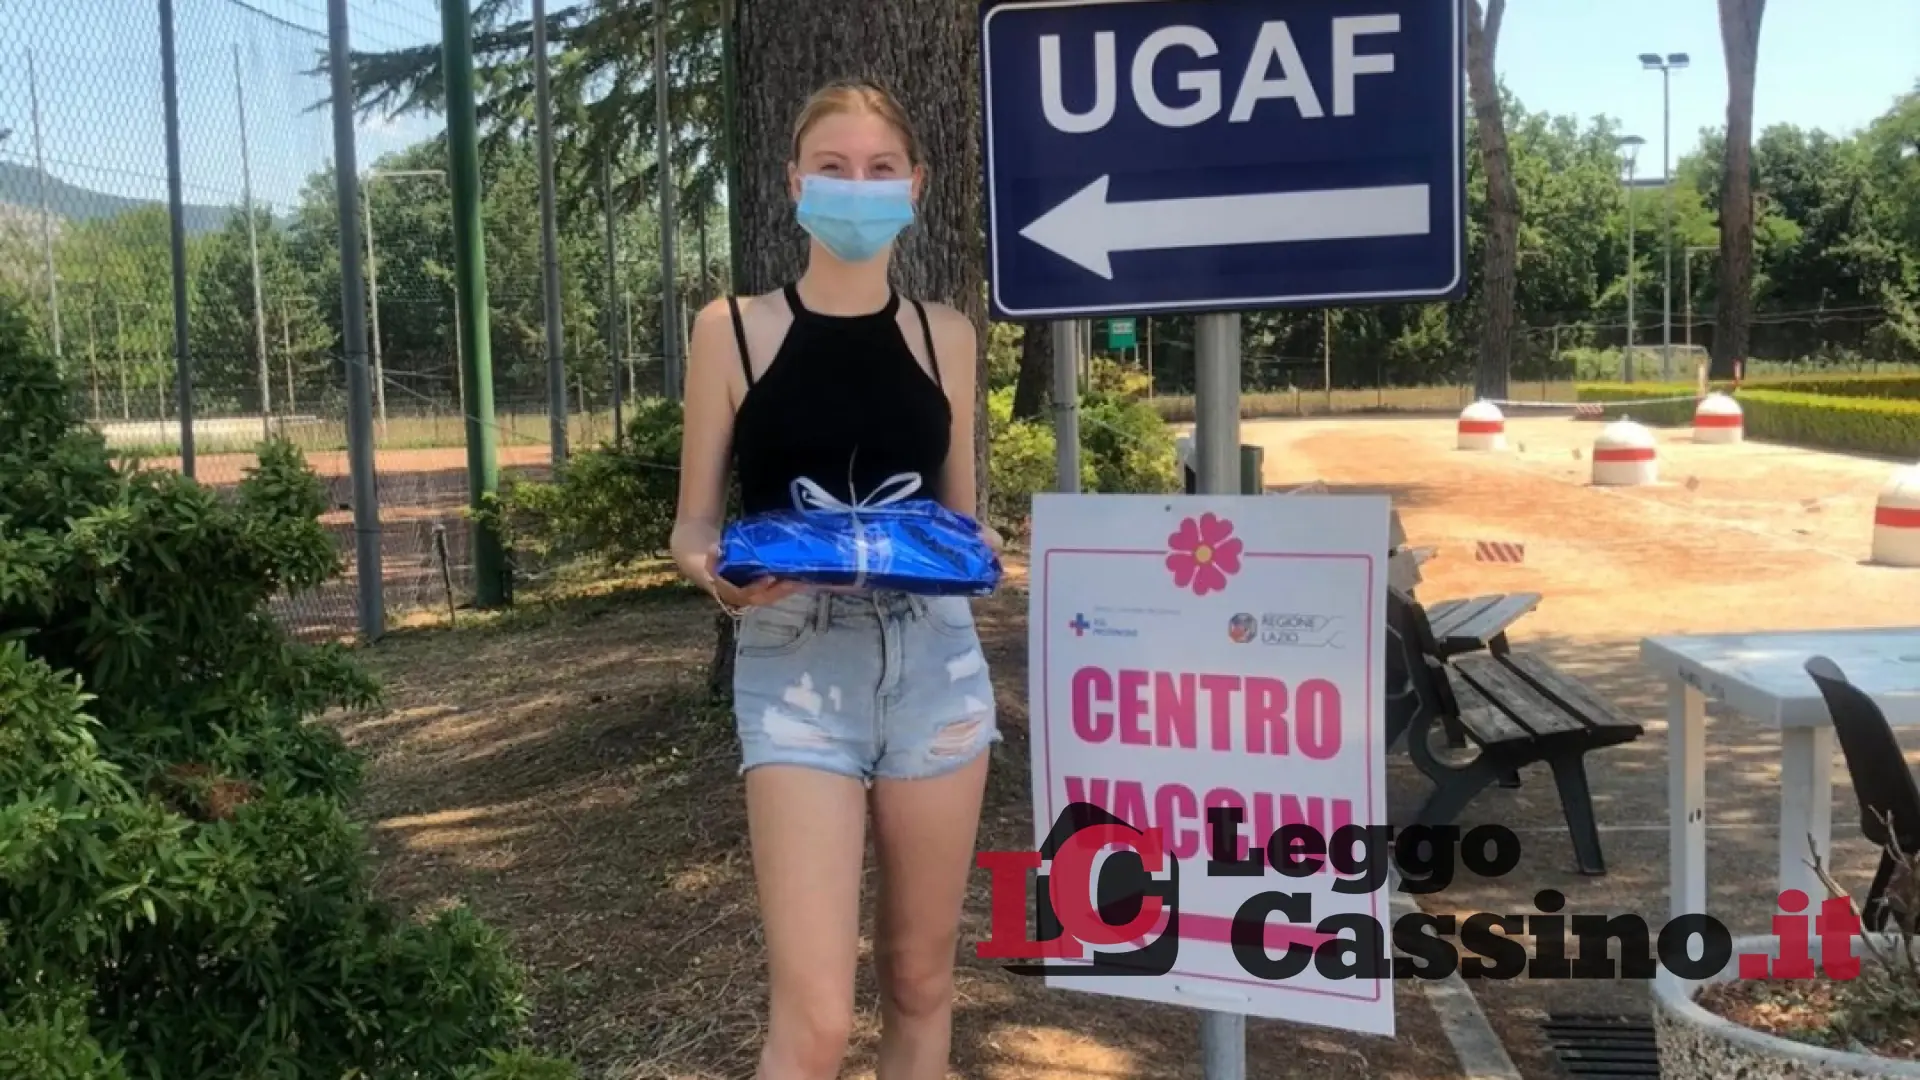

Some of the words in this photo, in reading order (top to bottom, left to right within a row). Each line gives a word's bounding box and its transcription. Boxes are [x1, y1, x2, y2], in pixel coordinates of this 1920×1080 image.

[1039, 14, 1401, 134] UGAF
[1071, 665, 1343, 761] CENTRO
[1064, 775, 1354, 876] VACCINI
